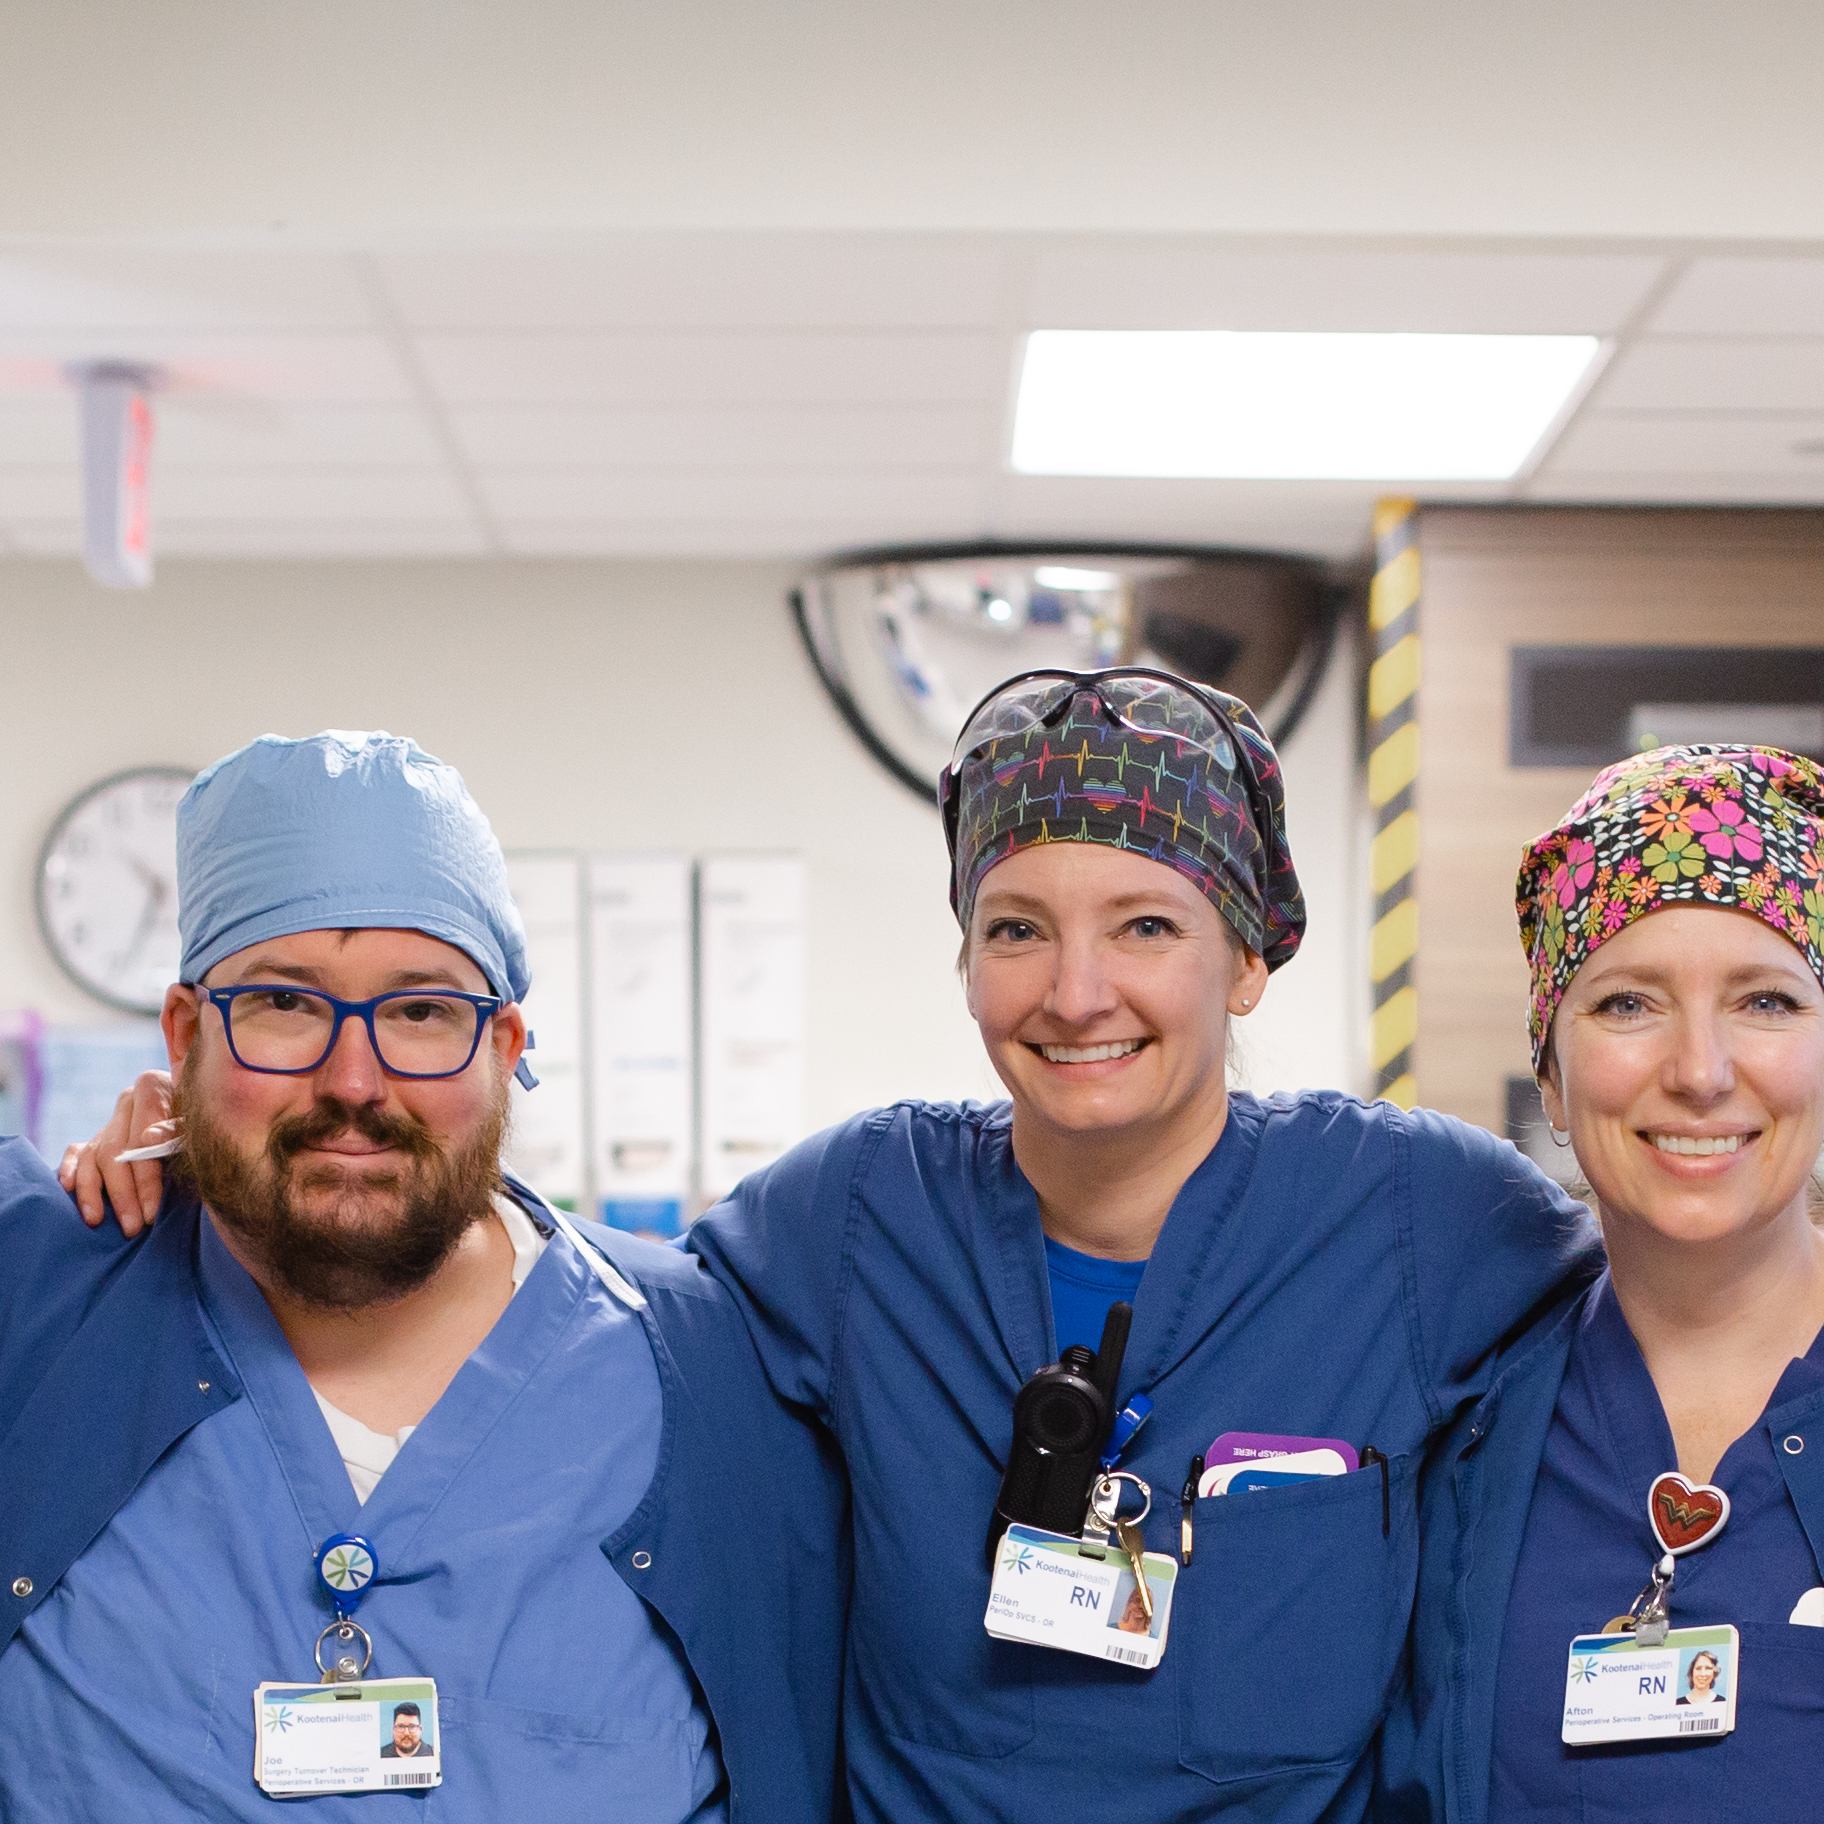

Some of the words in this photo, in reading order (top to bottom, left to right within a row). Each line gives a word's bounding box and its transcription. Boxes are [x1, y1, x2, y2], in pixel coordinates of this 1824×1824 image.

[1233, 1447, 1257, 1457] HERE
[1035, 1559, 1111, 1587] KootenaiHealth
[991, 1592, 1020, 1608] Ellen
[1069, 1585, 1102, 1611] RN
[989, 1604, 1015, 1618] PeriOp
[1601, 1659, 1674, 1674] KootenaiHealth
[1638, 1675, 1667, 1696] RN
[297, 1713, 374, 1724] KootenaiHealth
[1566, 1706, 1594, 1717] Afton
[1565, 1717, 1610, 1728] Perioperative
[1612, 1715, 1642, 1724] Services
[1648, 1711, 1683, 1722] Operating
[1683, 1710, 1705, 1719] Room
[264, 1756, 283, 1766] Joe
[264, 1767, 292, 1776] Surgery
[294, 1767, 328, 1775] Turnover
[329, 1766, 370, 1774] Technician
[264, 1778, 312, 1787] Perioperative
[314, 1777, 347, 1786] Services
[352, 1776, 365, 1785] OR
